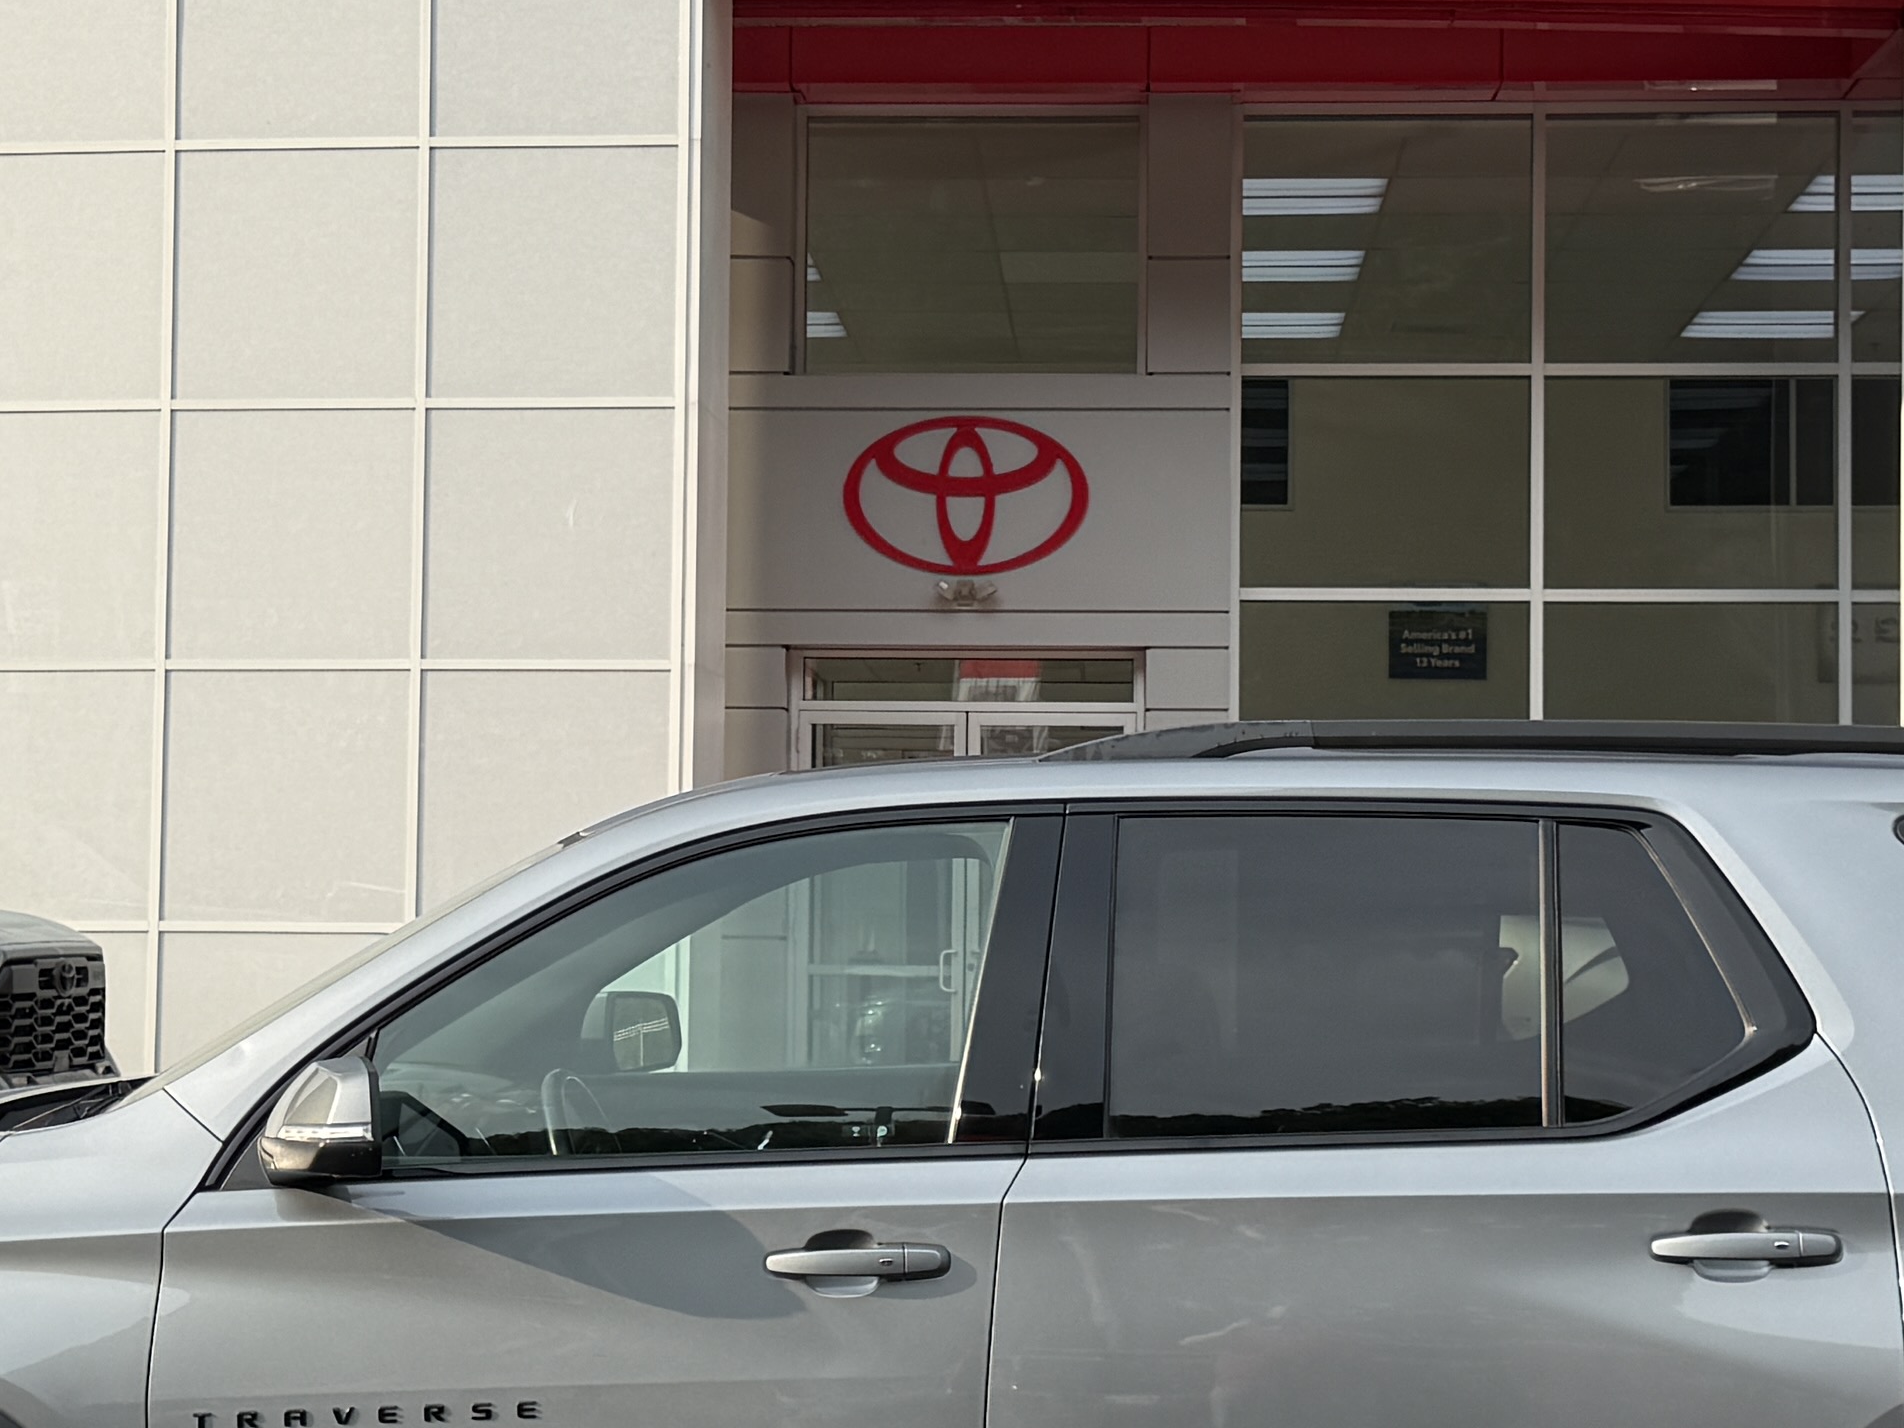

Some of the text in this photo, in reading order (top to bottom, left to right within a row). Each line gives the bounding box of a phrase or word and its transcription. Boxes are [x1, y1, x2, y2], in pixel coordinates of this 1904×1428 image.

[1402, 629, 1457, 640] America's
[1400, 642, 1476, 656] Selling Brand
[1429, 657, 1461, 668] Years
